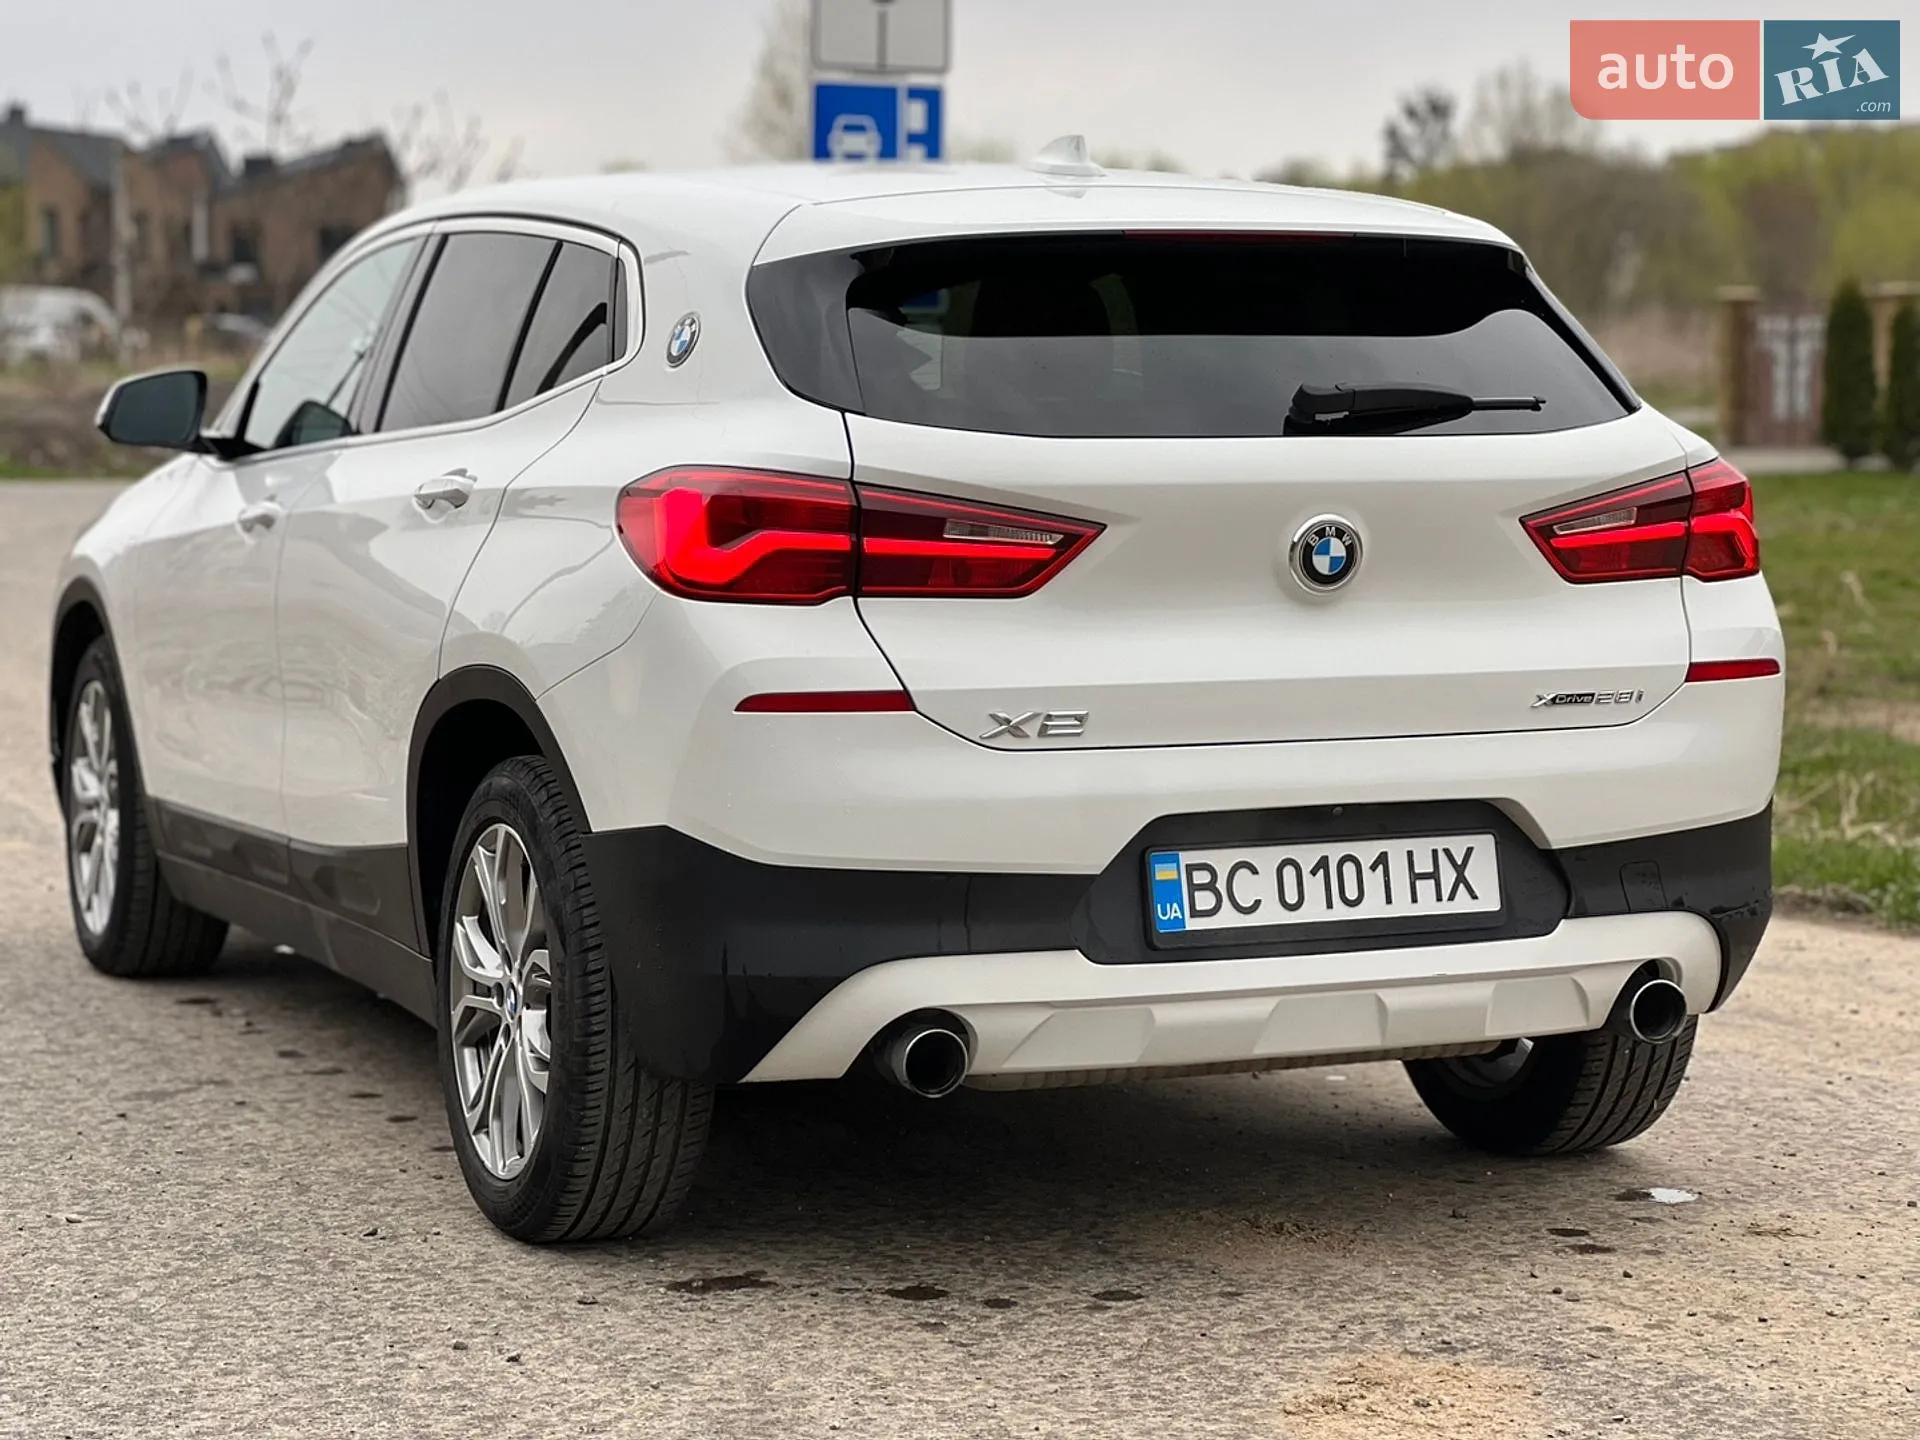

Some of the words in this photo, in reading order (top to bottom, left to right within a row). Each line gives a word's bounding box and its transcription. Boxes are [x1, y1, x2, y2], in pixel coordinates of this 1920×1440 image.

[1307, 526, 1352, 546] BMW
[1185, 862, 1262, 918] BC
[1276, 850, 1394, 912] 0101
[1406, 846, 1479, 904] HX
[1157, 903, 1183, 921] UA
